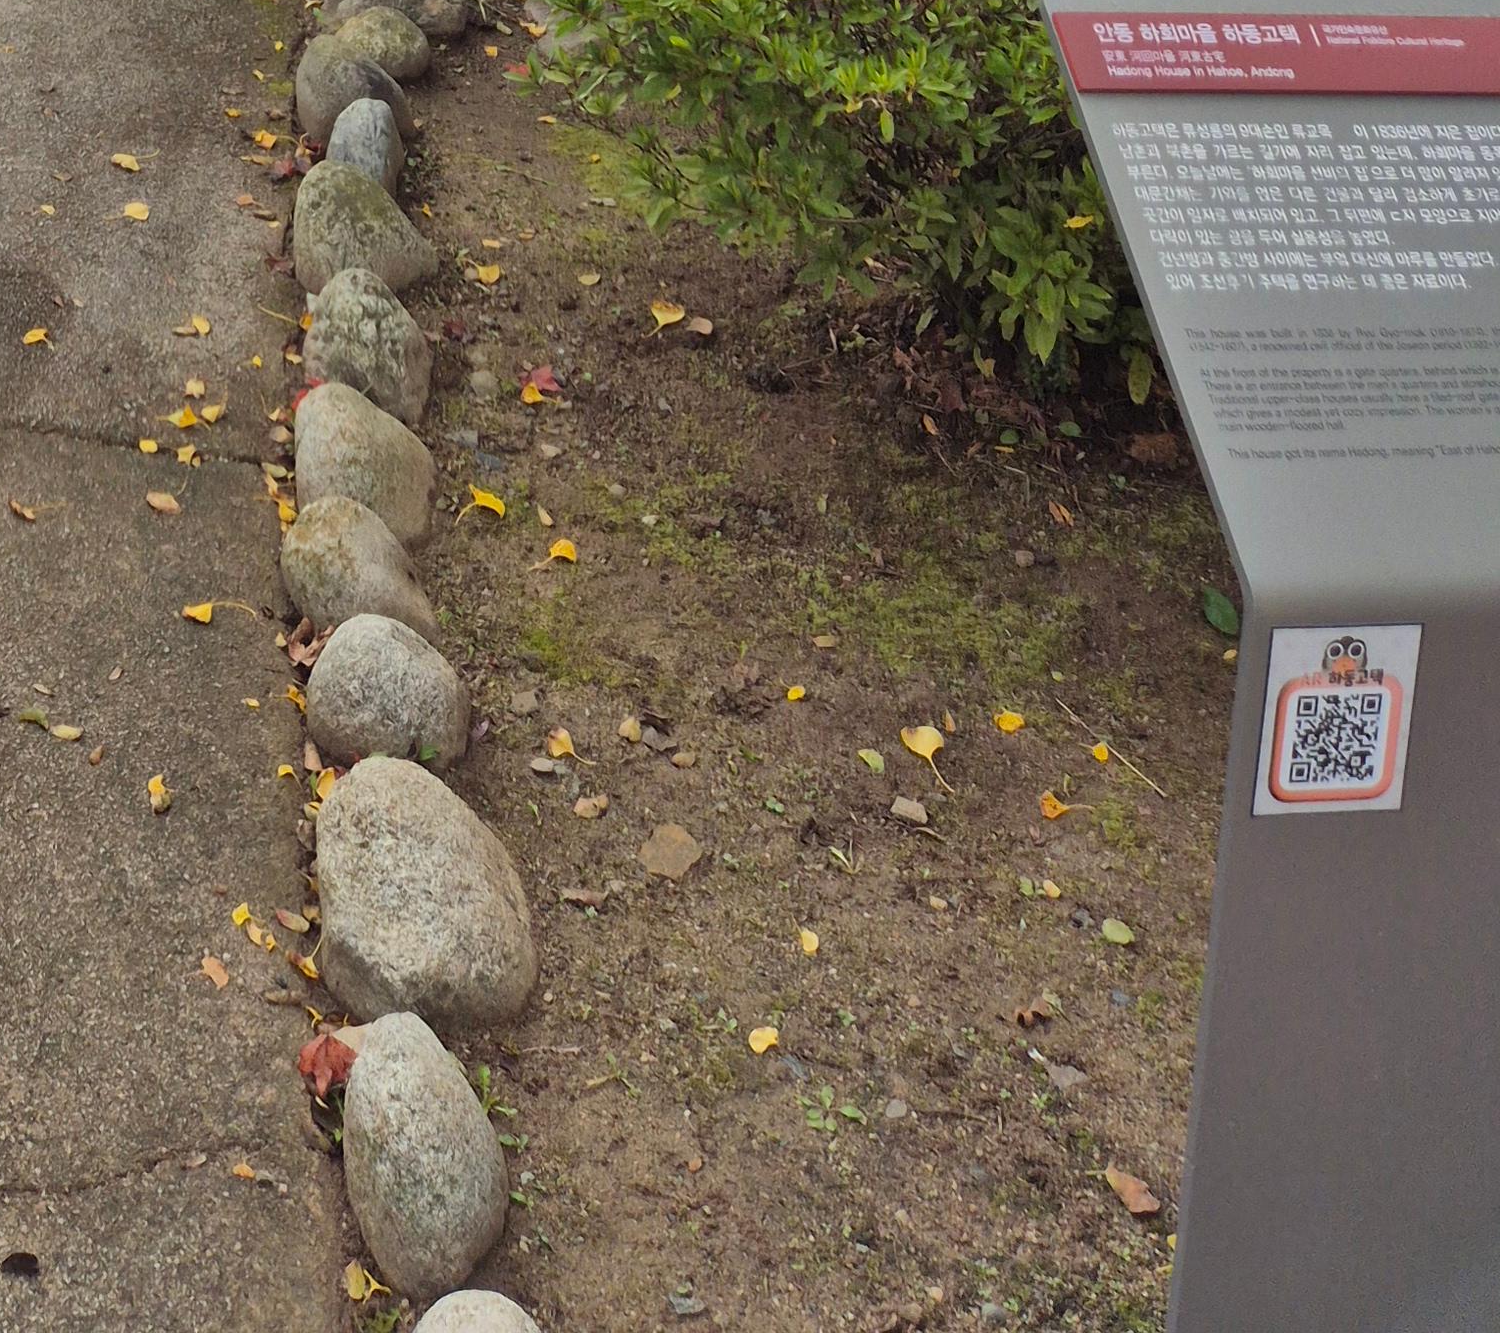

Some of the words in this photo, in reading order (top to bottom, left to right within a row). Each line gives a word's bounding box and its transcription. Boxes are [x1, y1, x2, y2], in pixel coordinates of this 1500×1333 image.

[1093, 22, 1133, 42] 안동
[1139, 23, 1217, 42] 하회마을
[1222, 24, 1301, 43] 하동고택
[1106, 66, 1152, 76] Hadong
[1154, 67, 1191, 76] House
[1192, 66, 1204, 76] in
[1206, 66, 1247, 76] Hahoe,
[1250, 67, 1294, 78] Andong
[1353, 124, 1368, 137] 이
[1371, 124, 1432, 139] 1836년에
[1400, 166, 1416, 179] 더
[1329, 667, 1384, 687] 하동고택
